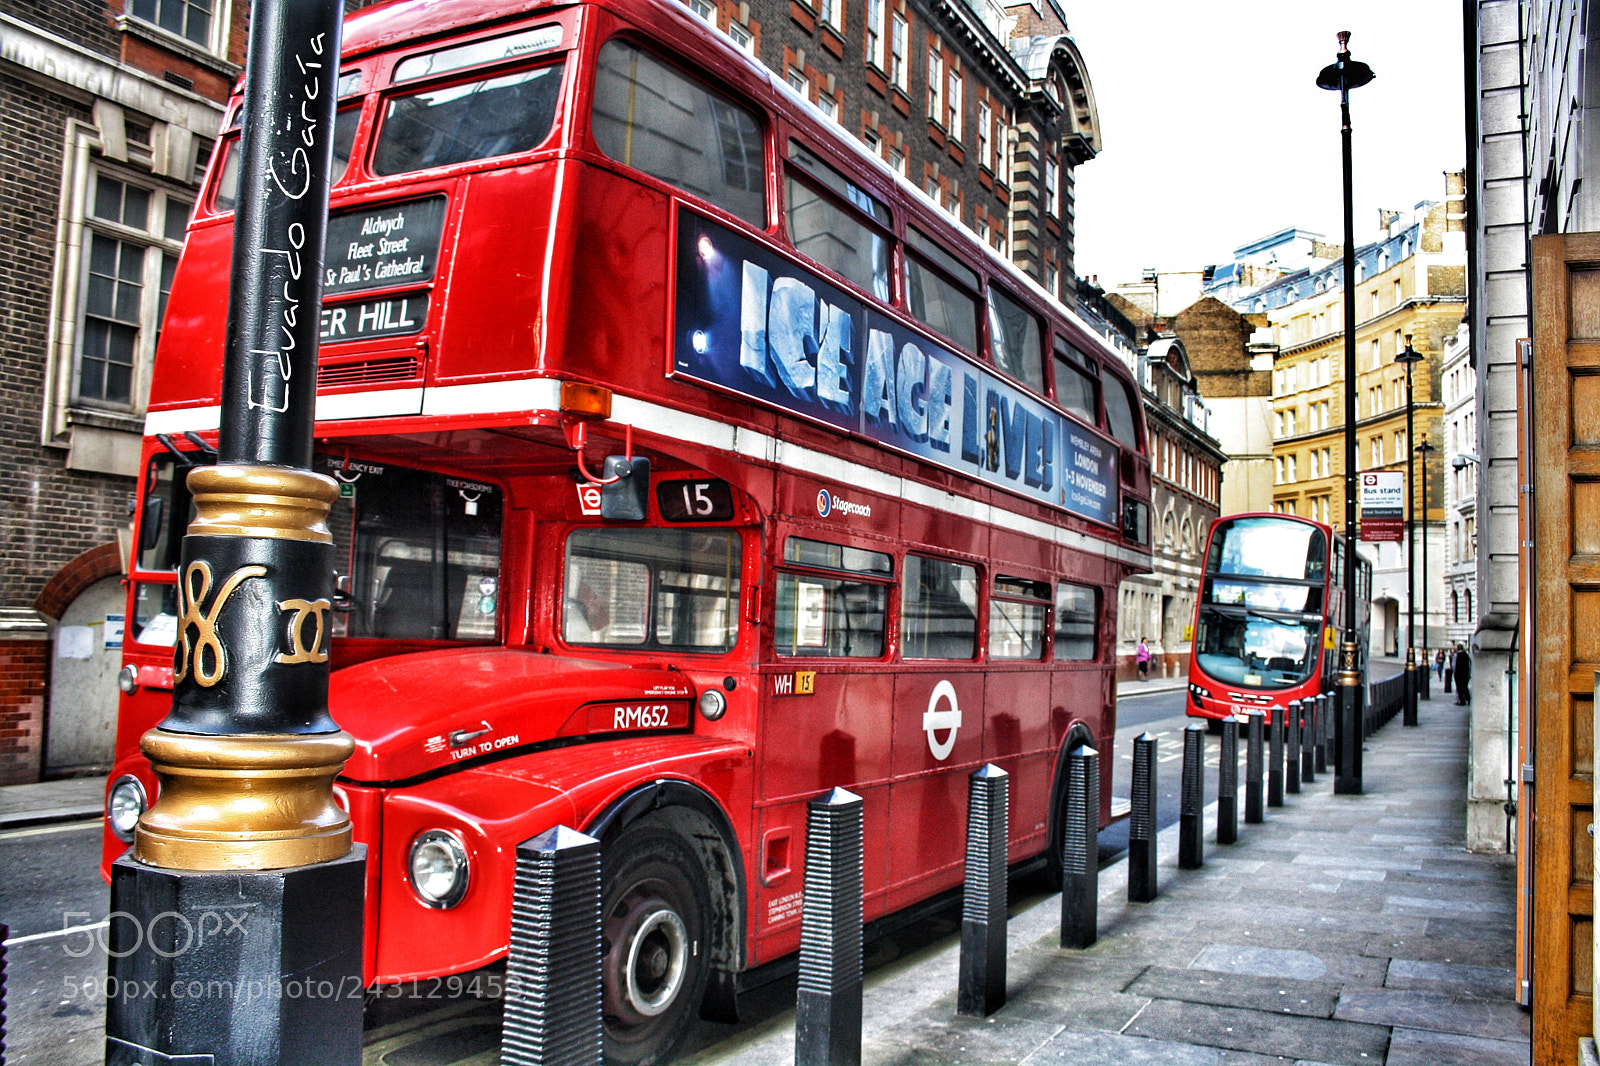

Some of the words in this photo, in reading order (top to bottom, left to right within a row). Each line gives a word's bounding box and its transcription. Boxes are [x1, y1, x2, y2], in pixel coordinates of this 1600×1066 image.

[361, 212, 404, 237] Aldwych
[347, 242, 375, 260] Fleet
[377, 237, 410, 256] Street
[324, 268, 338, 287] St
[338, 263, 372, 285] Paul's
[374, 255, 425, 279] Cathedral
[320, 308, 347, 337] ER
[358, 299, 415, 333] HILL
[739, 259, 855, 417] ICE
[860, 328, 953, 454] AGE
[961, 371, 1055, 493] LIVE!
[326, 458, 369, 474] EMERENCY
[368, 465, 384, 475] EXIT
[1074, 451, 1099, 476] LONDON
[1065, 468, 1076, 485] 1-3
[1075, 472, 1107, 498] NOVEMBER
[682, 483, 714, 516] 15
[832, 495, 871, 517] Stagecoach
[774, 674, 793, 694] WH
[801, 675, 811, 691] 15
[613, 705, 669, 729] RM652
[450, 745, 477, 760] TURN
[479, 742, 493, 752] TO
[494, 734, 520, 749] OPEN
